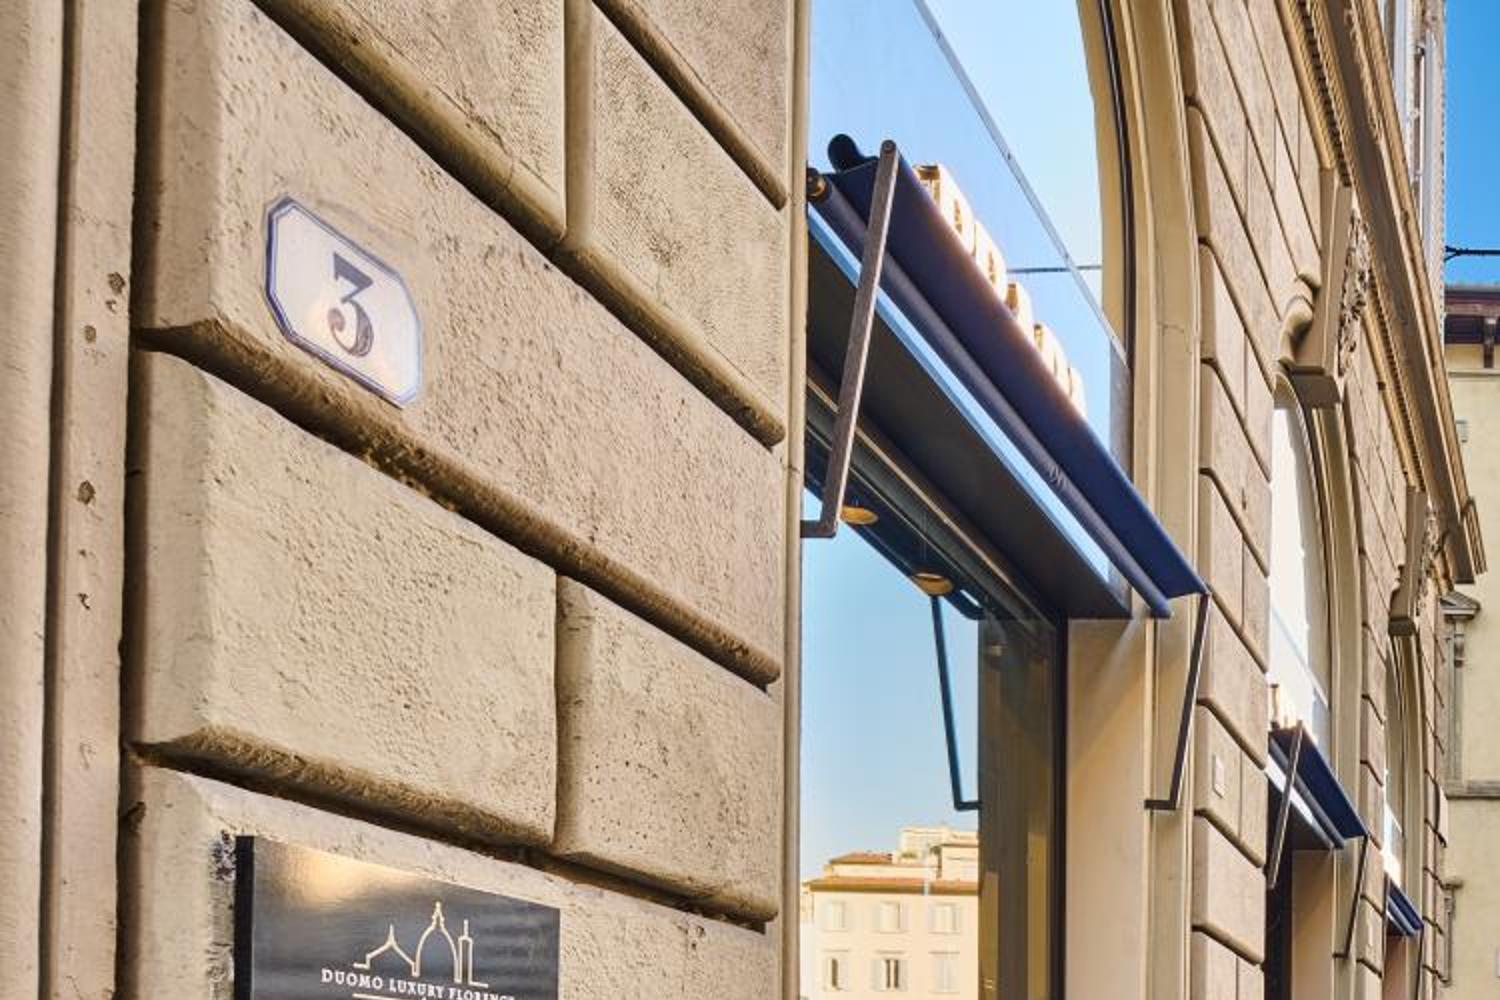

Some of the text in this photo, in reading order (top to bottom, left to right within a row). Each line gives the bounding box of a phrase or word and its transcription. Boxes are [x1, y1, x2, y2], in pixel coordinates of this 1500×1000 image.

[328, 252, 375, 358] 3
[321, 968, 383, 990] DUOMO
[389, 977, 444, 999] LUXURY
